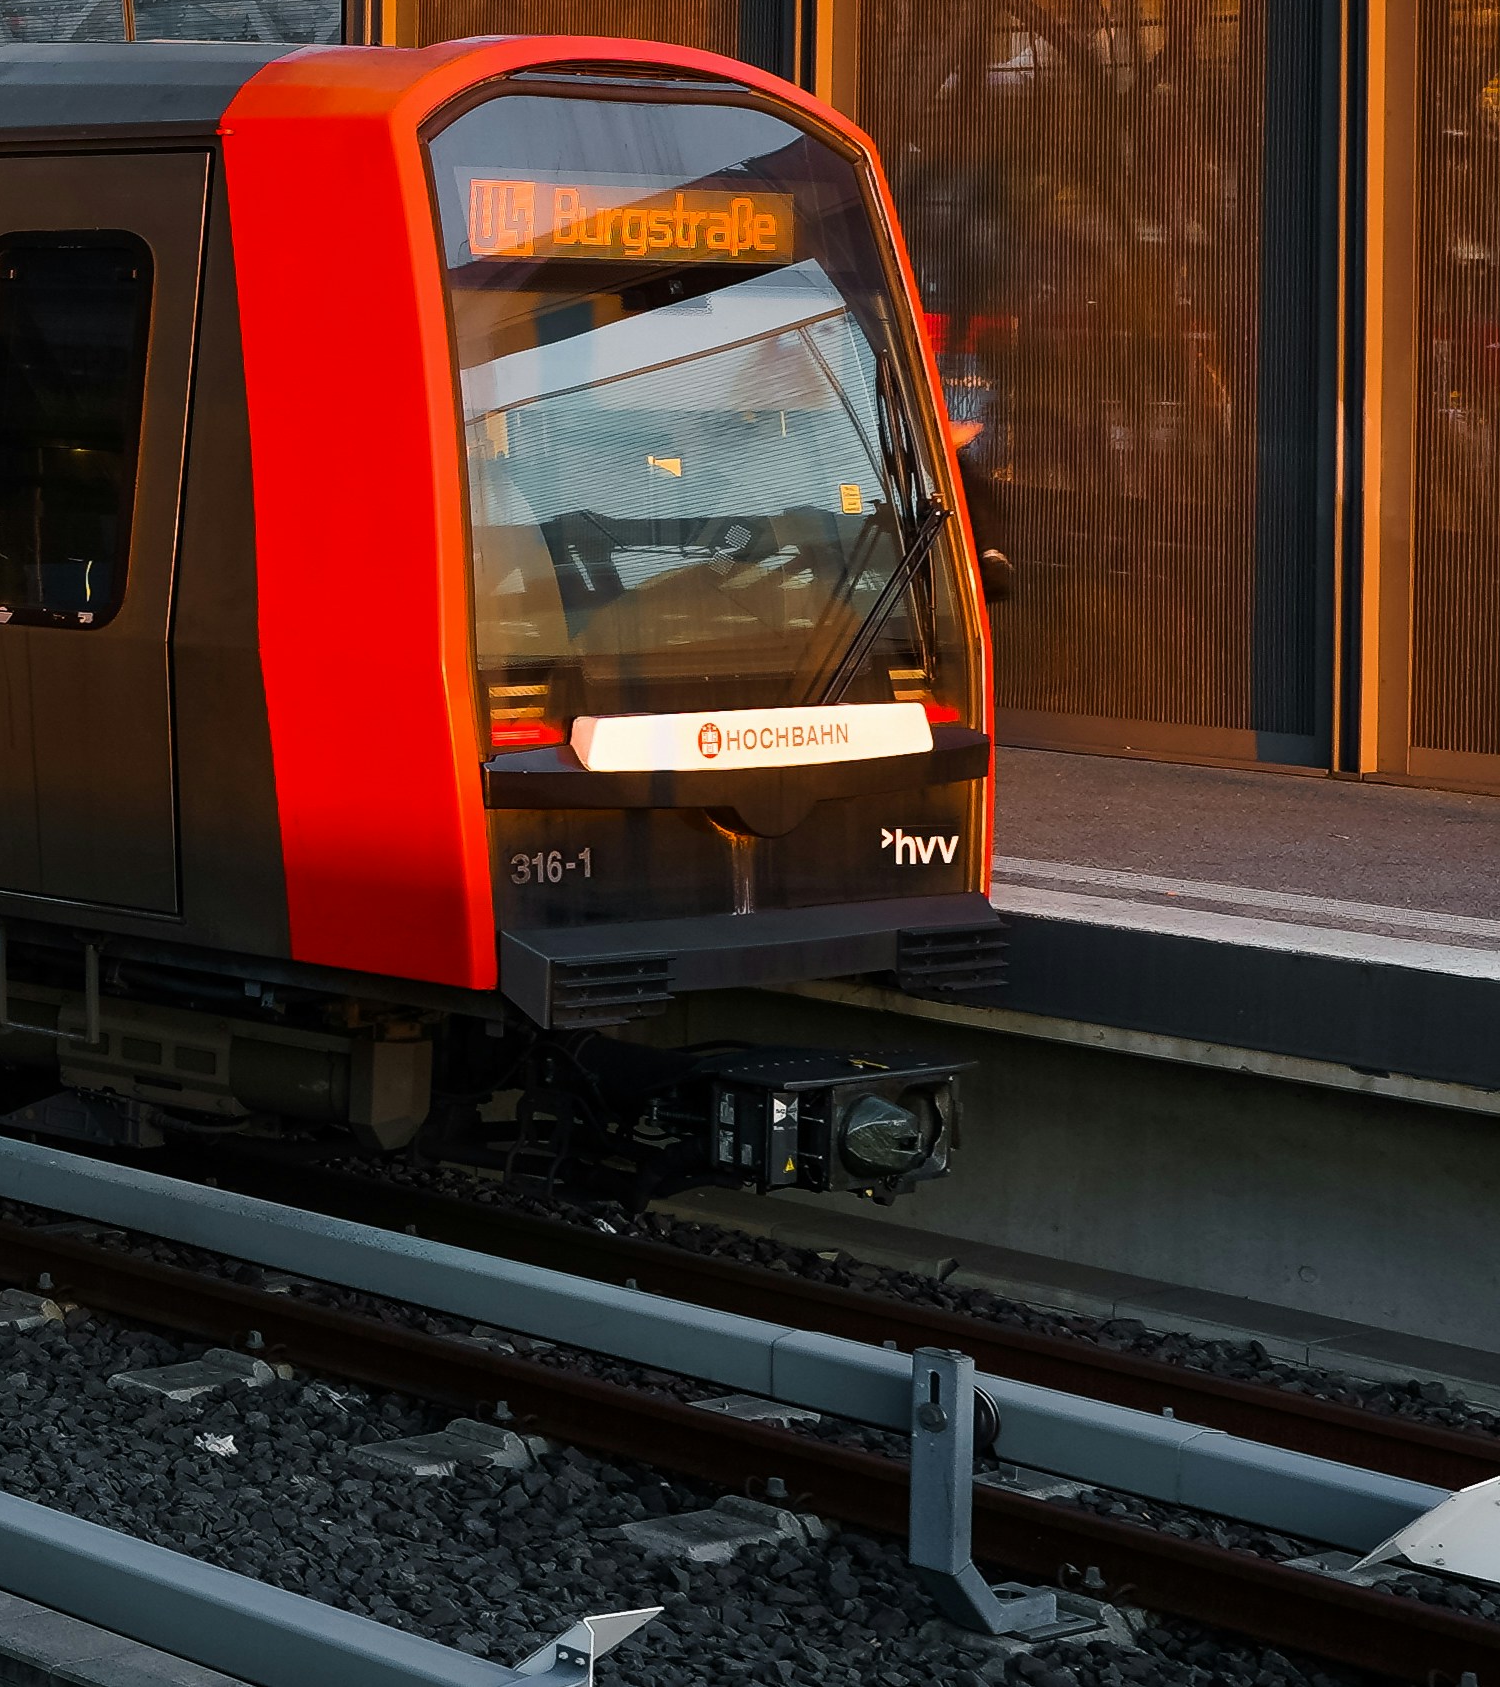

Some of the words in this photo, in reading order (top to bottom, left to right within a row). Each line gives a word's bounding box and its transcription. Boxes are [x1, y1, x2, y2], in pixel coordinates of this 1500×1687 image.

[474, 185, 528, 250] U4
[553, 187, 778, 257] Burgstraße
[726, 723, 849, 751] HOCHBAHN
[510, 847, 592, 885] 316-1
